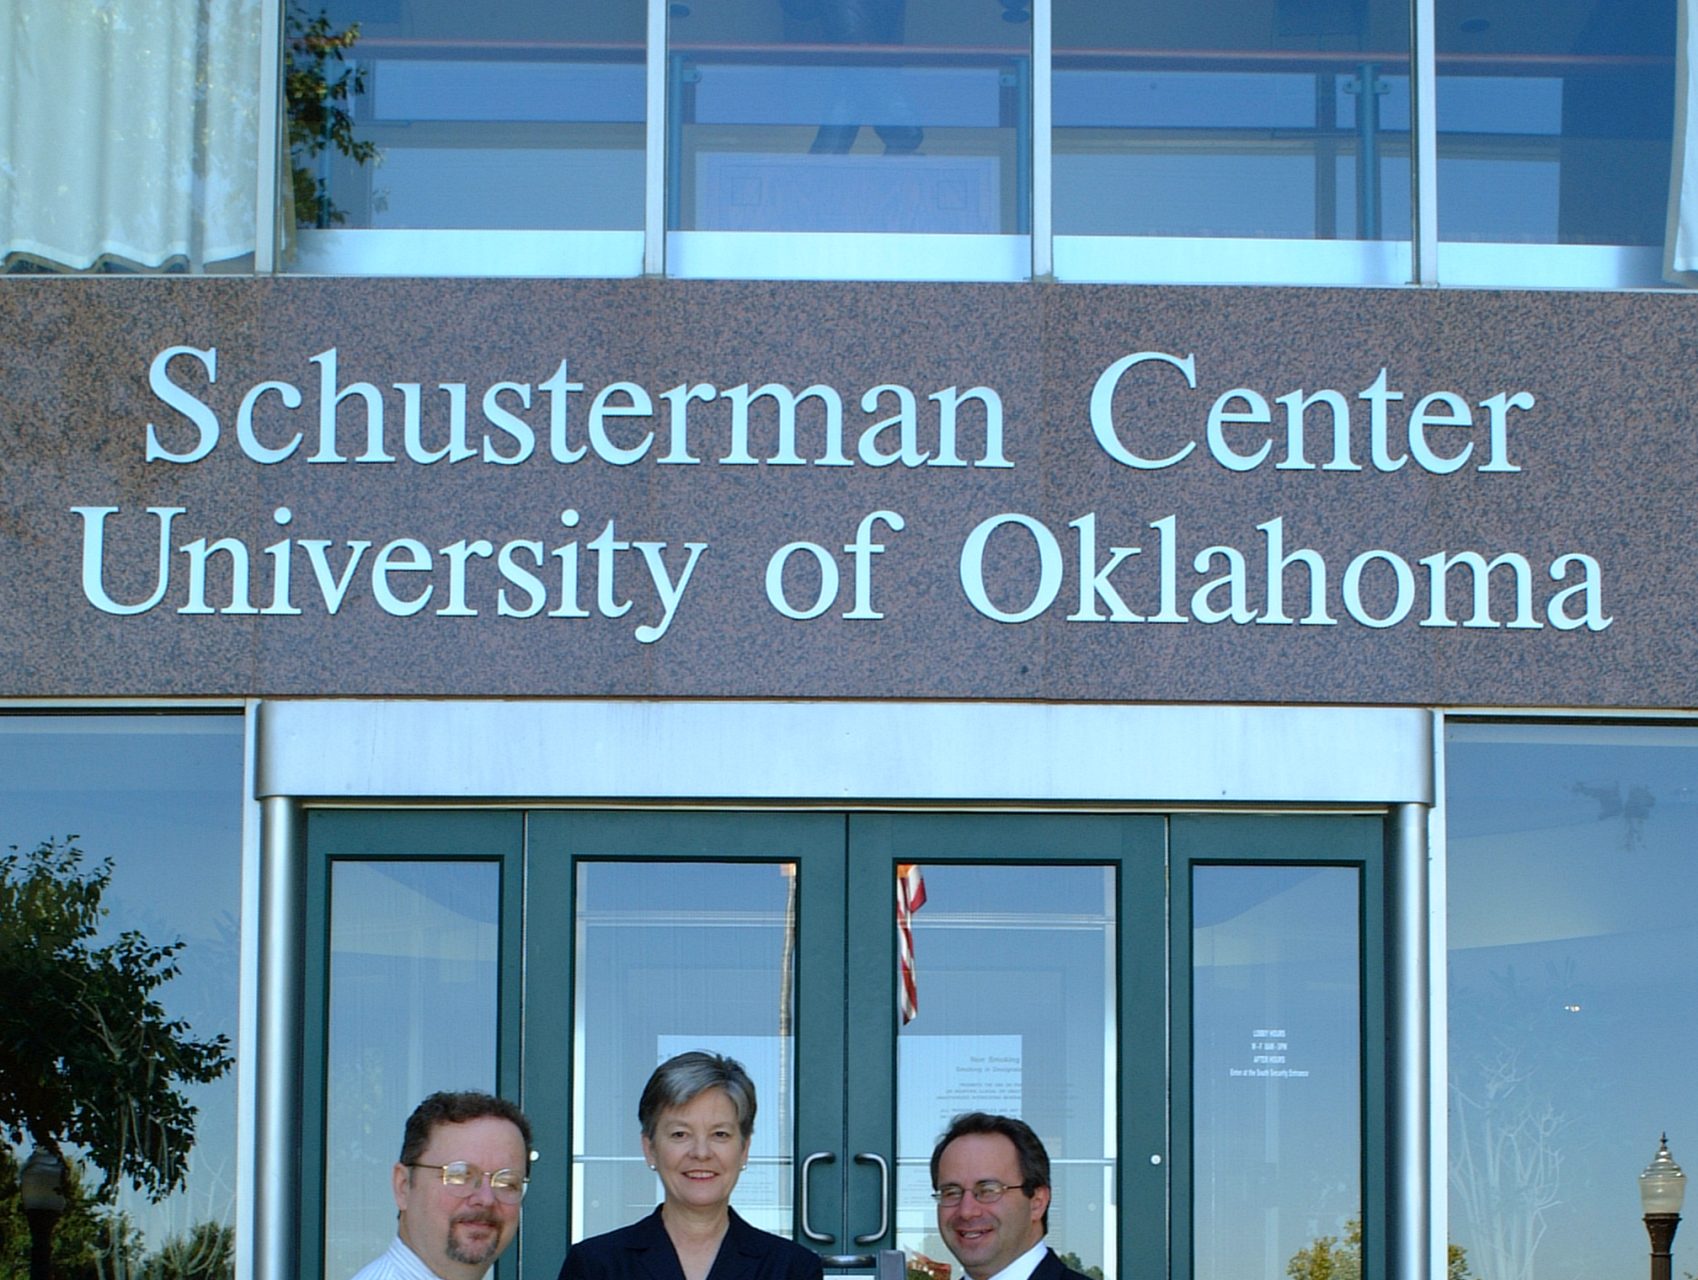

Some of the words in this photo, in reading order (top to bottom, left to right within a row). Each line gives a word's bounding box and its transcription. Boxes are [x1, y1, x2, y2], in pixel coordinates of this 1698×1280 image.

[146, 345, 1015, 469] Schusterman
[1089, 351, 1536, 474] Center
[70, 506, 708, 644] University
[765, 510, 905, 624] of
[959, 512, 1614, 632] Oklahoma
[1252, 1029, 1268, 1037] LOBBY
[1269, 1029, 1286, 1037] HOURS
[988, 1056, 1020, 1064] Smoking
[1253, 1055, 1268, 1063] AFTER
[1269, 1055, 1286, 1063] HOURS
[1229, 1068, 1242, 1076] Enter
[1270, 1068, 1288, 1079] Security
[1288, 1068, 1309, 1077] Entrance
